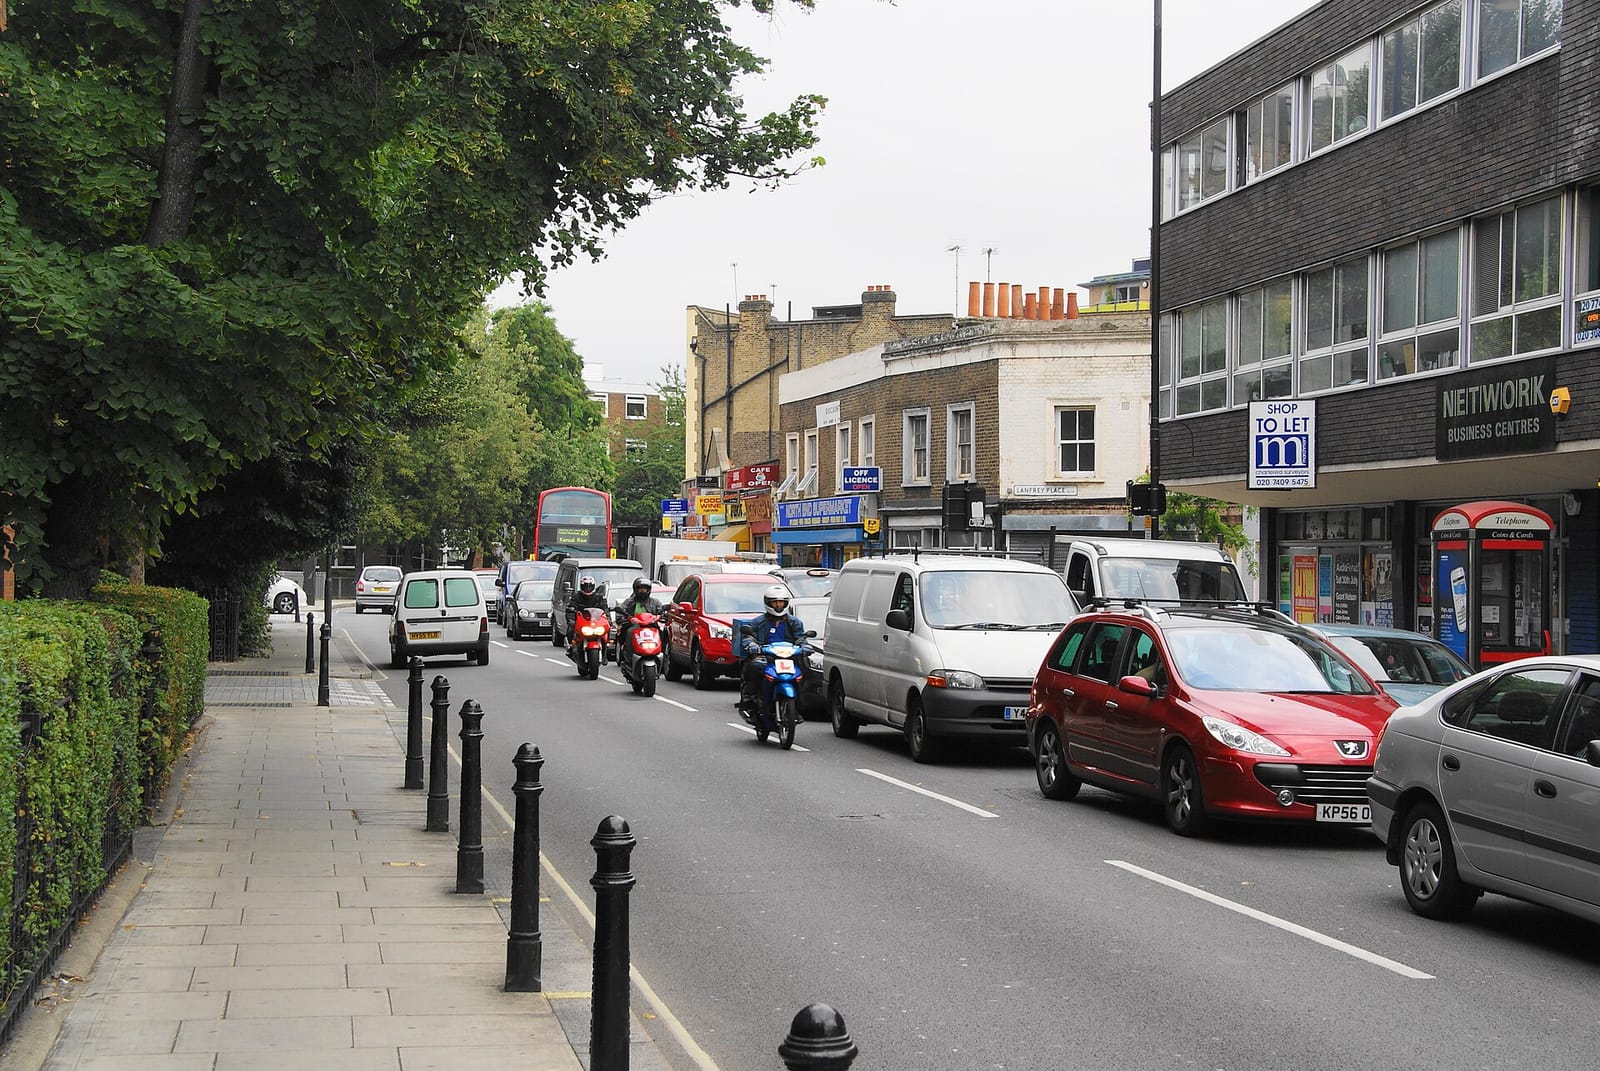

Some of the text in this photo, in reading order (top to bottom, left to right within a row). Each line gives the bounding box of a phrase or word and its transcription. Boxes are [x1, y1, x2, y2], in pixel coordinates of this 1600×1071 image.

[1267, 403, 1298, 414] SHOP
[1255, 417, 1310, 433] TO LET
[1448, 417, 1540, 443] BUSINESS CENTRES
[853, 469, 869, 477] OFF
[813, 499, 852, 516] SUPERMARKET
[1495, 516, 1530, 526] Telephone
[1322, 805, 1358, 820] KP56
